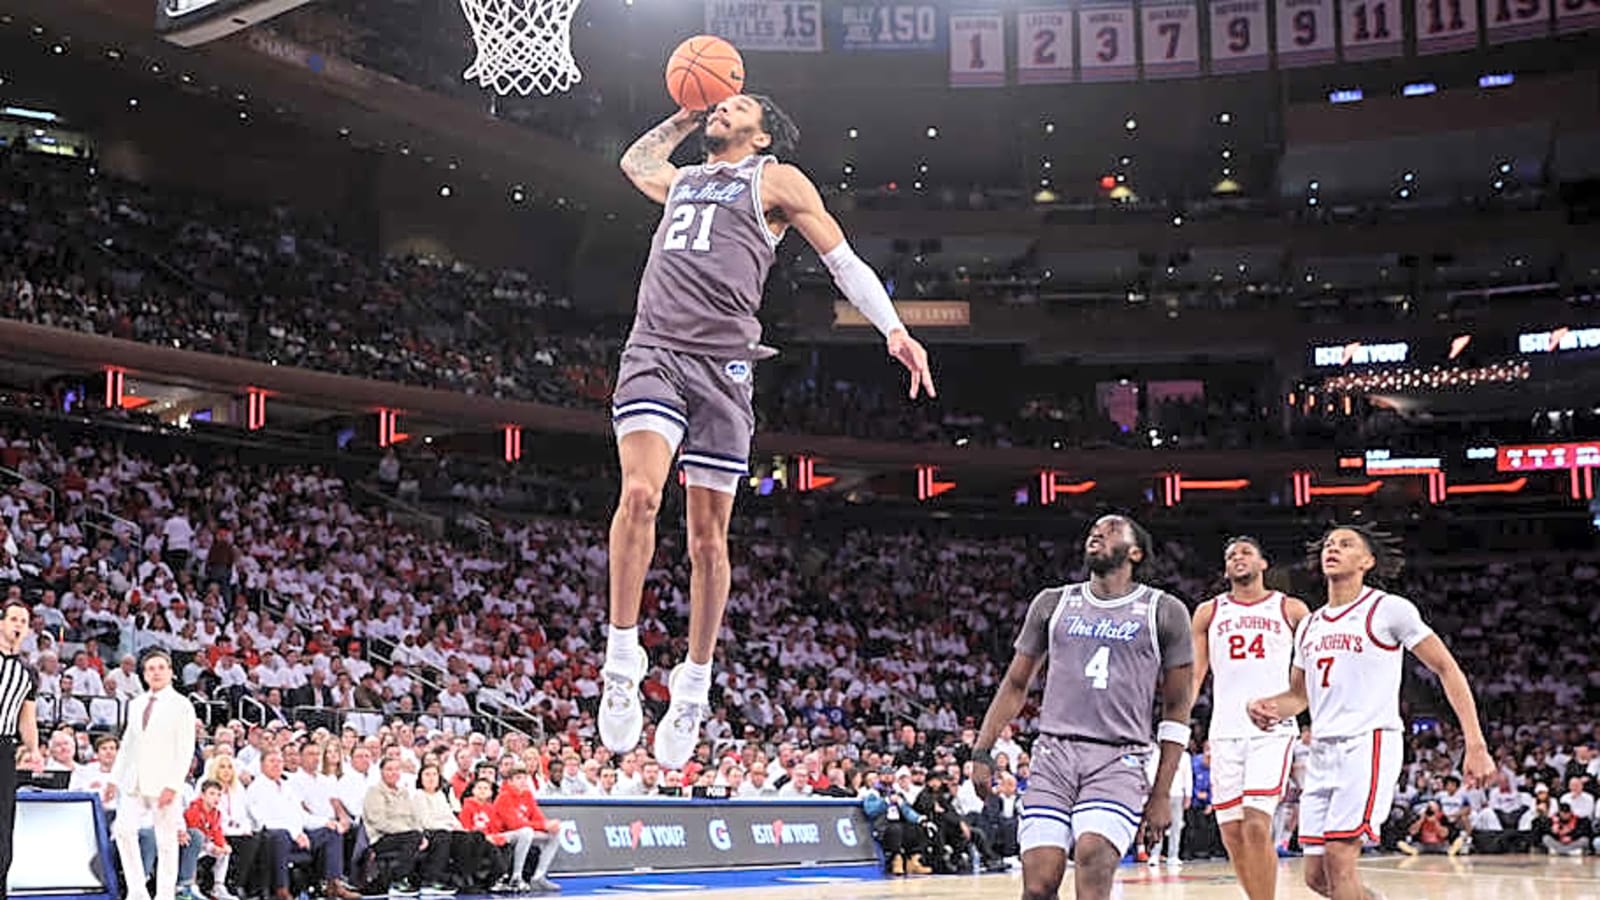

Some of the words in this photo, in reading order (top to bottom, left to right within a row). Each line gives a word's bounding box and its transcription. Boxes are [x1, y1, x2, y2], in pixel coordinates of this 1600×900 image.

[783, 4, 816, 38] 15
[878, 5, 936, 41] 150
[1228, 16, 1250, 52] 9
[1293, 9, 1317, 46] 9
[1353, 2, 1390, 41] 11
[1428, 0, 1463, 34] 11
[969, 33, 984, 69] 1
[1033, 30, 1056, 65] 2
[1096, 27, 1119, 62] 3
[1158, 22, 1181, 59] 7
[695, 180, 747, 202] Hall
[663, 202, 718, 252] 21
[1065, 615, 1095, 636] The
[1093, 618, 1141, 641] Hall
[1234, 615, 1281, 634] JOHN'S
[1228, 633, 1265, 659] 24
[1315, 633, 1363, 653] JOHN'S
[1084, 646, 1111, 689] 4
[1316, 656, 1335, 688] 7
[559, 819, 583, 854] G
[652, 825, 686, 848] YOU?
[708, 819, 732, 850] G
[836, 818, 858, 847] G
